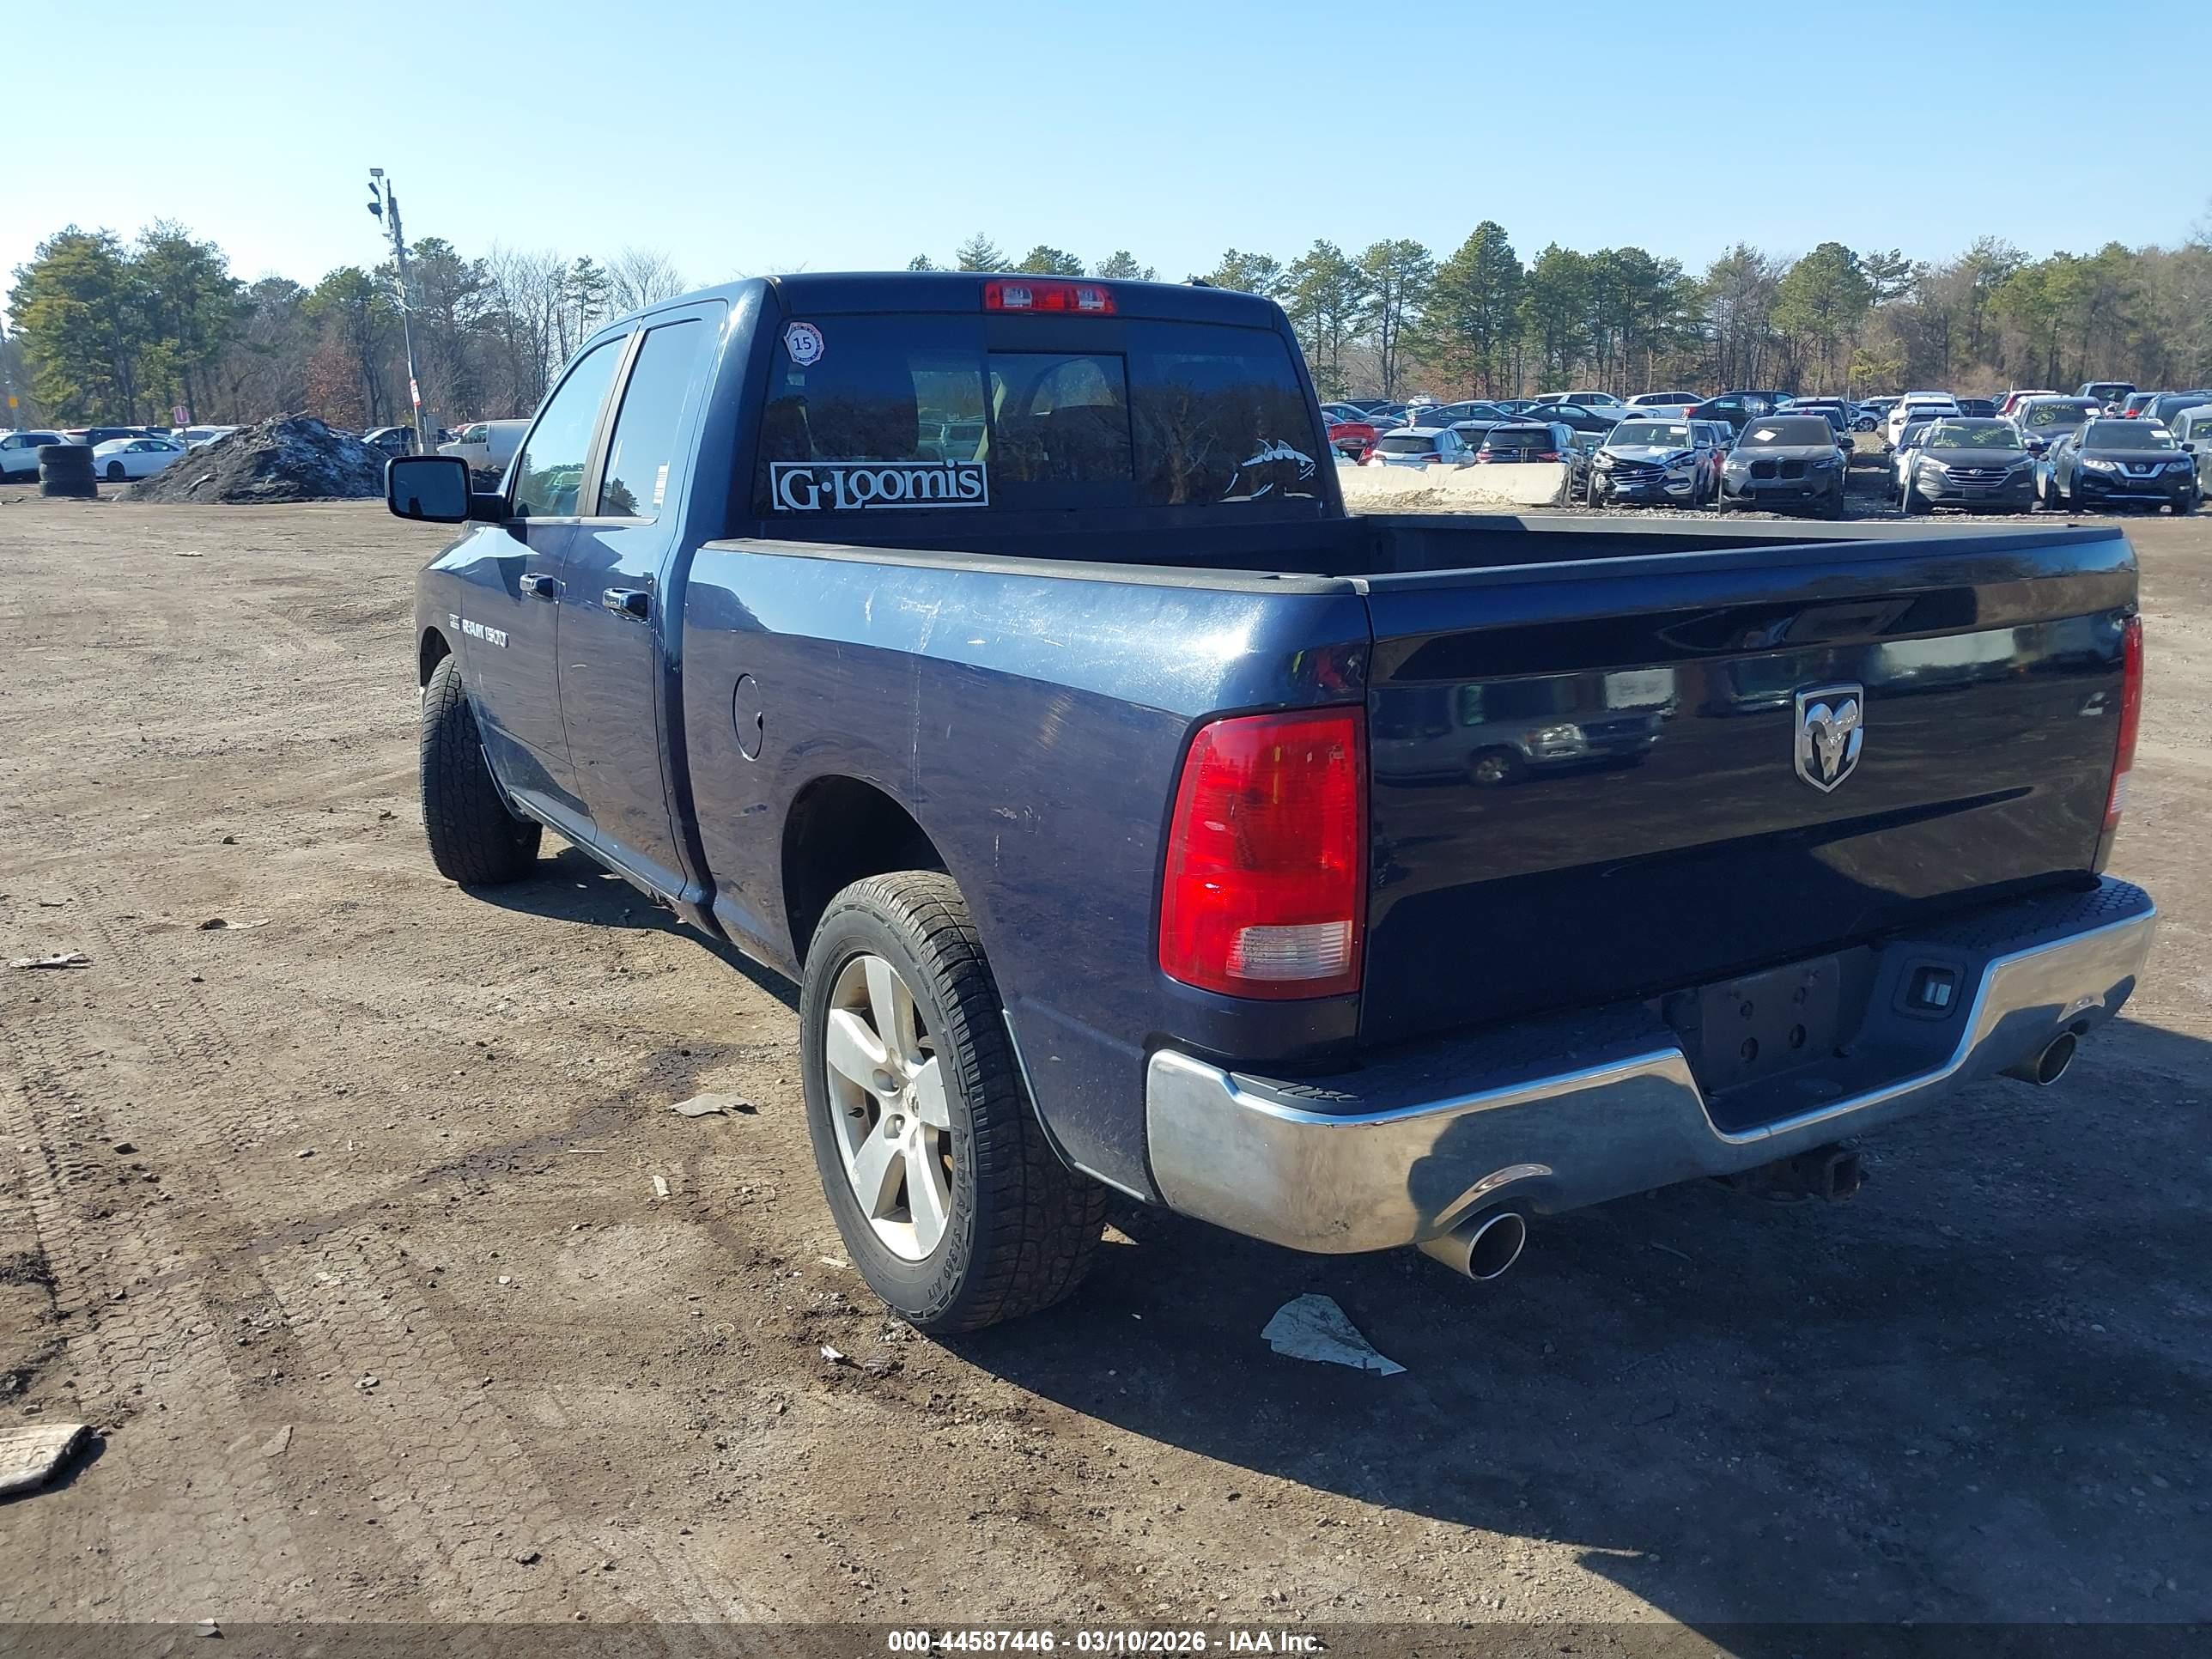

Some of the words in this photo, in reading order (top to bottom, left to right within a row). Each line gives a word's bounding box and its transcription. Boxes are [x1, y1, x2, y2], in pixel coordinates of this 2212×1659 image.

[793, 336, 812, 351] 15
[462, 619, 484, 639] RAM
[485, 627, 508, 648] 1500
